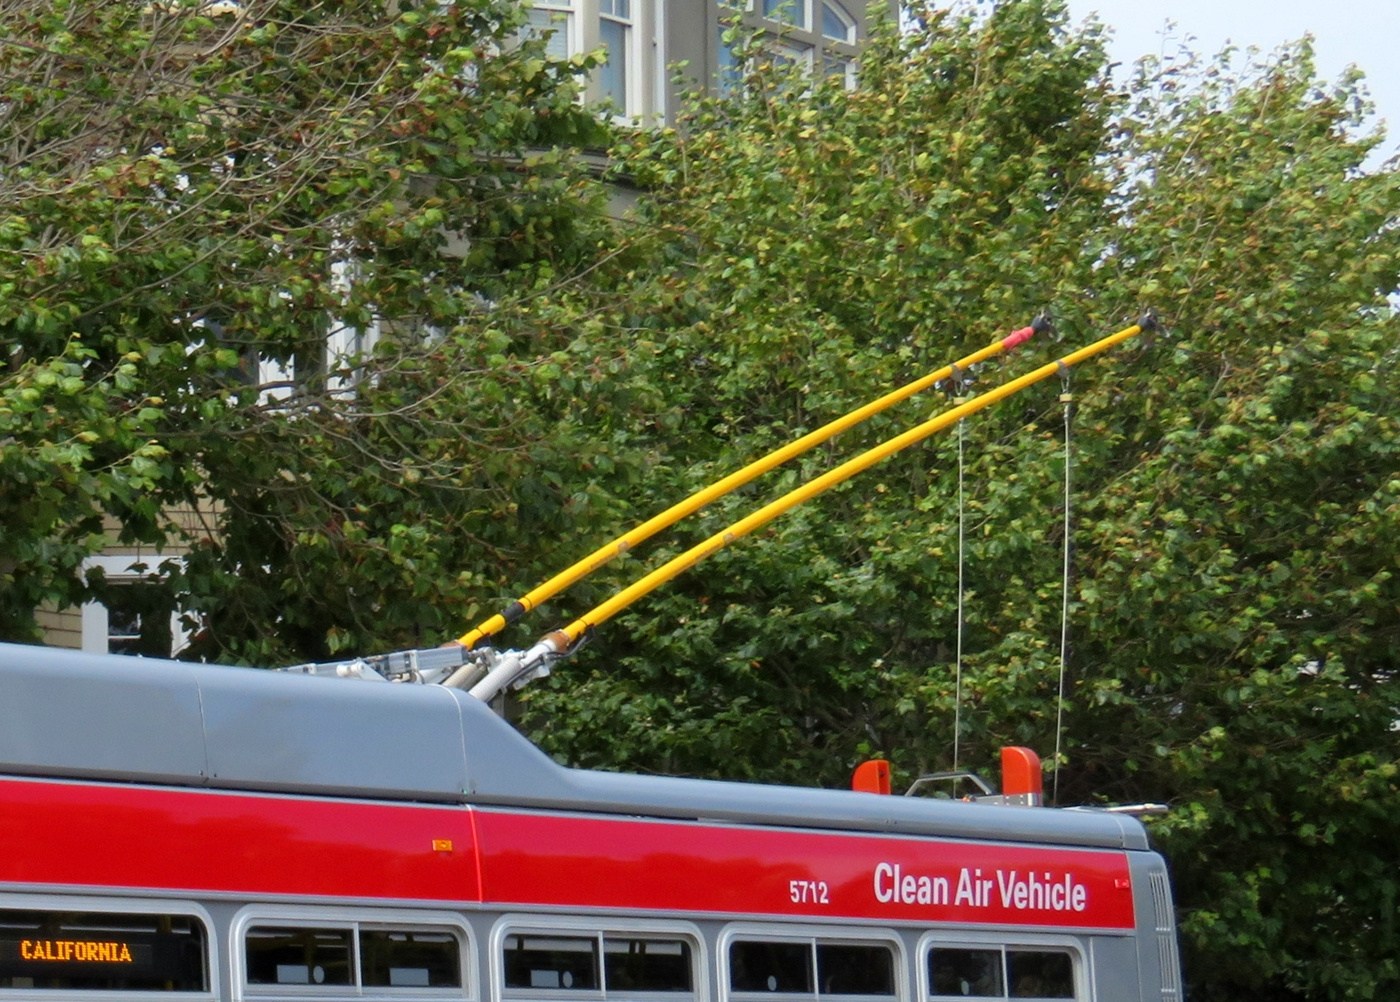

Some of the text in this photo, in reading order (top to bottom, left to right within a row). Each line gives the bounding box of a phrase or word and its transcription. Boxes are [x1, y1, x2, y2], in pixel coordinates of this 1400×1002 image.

[789, 880, 830, 904] 5712
[873, 862, 1086, 912] Clean Air Vehicle
[20, 939, 133, 963] CALIFORNIA
